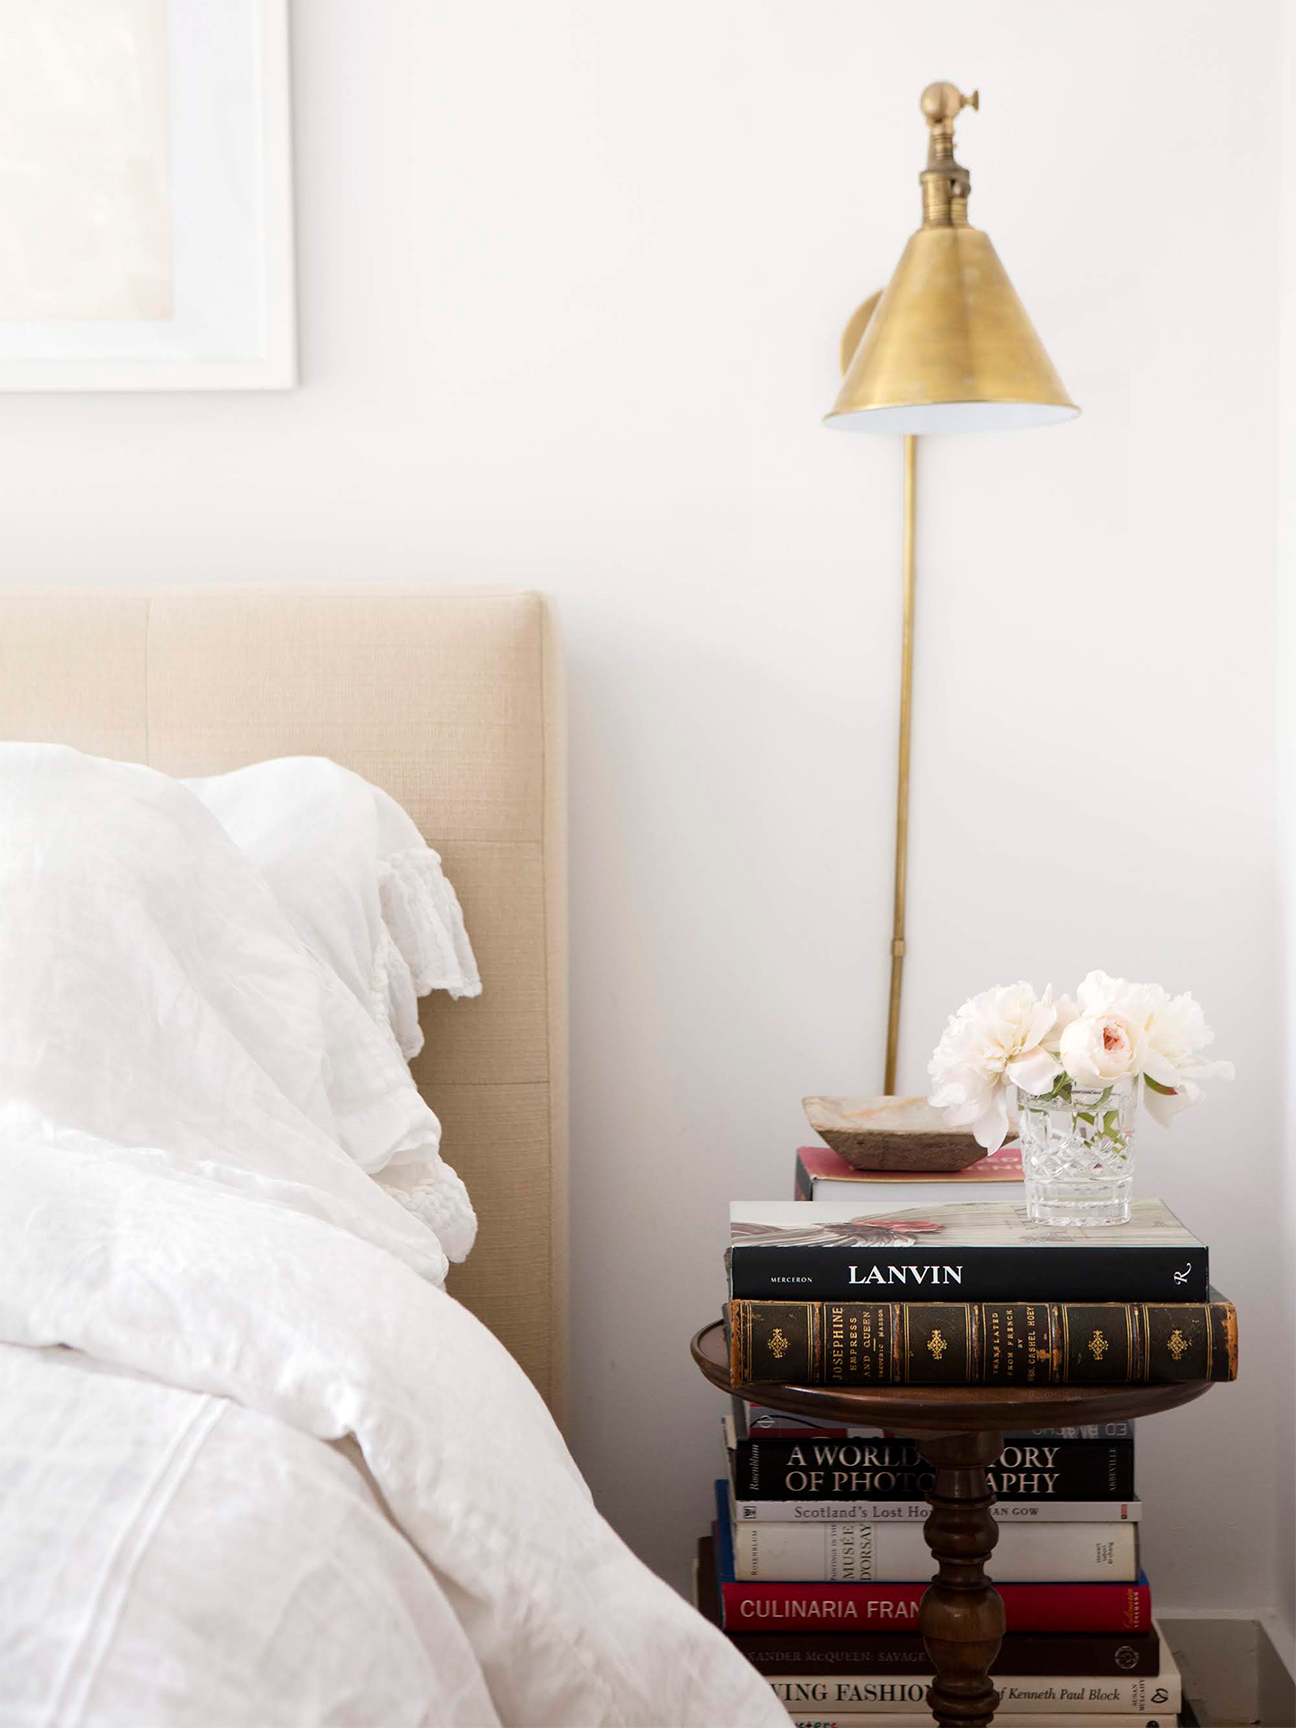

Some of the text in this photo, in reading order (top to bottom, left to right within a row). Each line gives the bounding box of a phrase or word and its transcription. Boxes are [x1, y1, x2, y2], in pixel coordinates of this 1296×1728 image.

[848, 1265, 963, 1285] LANVIN
[1173, 1262, 1192, 1286] R
[832, 1307, 844, 1380] JOSEPHINE
[850, 1317, 858, 1371] EMPRESS
[863, 1311, 871, 1378] AND QUEEN
[992, 1312, 1000, 1375] TRANSLATED
[1028, 1330, 1036, 1365] CASHEL
[1105, 1422, 1128, 1436] ED
[749, 1444, 760, 1491] Rosenblum
[786, 1445, 1061, 1468] A WORLD ORY
[785, 1471, 825, 1492] OF
[794, 1506, 868, 1518] Scotland's
[873, 1506, 902, 1518] Lost
[989, 1507, 1039, 1516] AN GOW
[840, 1525, 854, 1580] MUSÉE
[859, 1524, 872, 1581] D'ORSAY
[740, 1599, 859, 1618] CULINARIA
[877, 1651, 927, 1662] SAVAGE
[1008, 1687, 1056, 1700] Kenneth
[1060, 1688, 1085, 1701] Paul
[1089, 1689, 1120, 1701] Block
